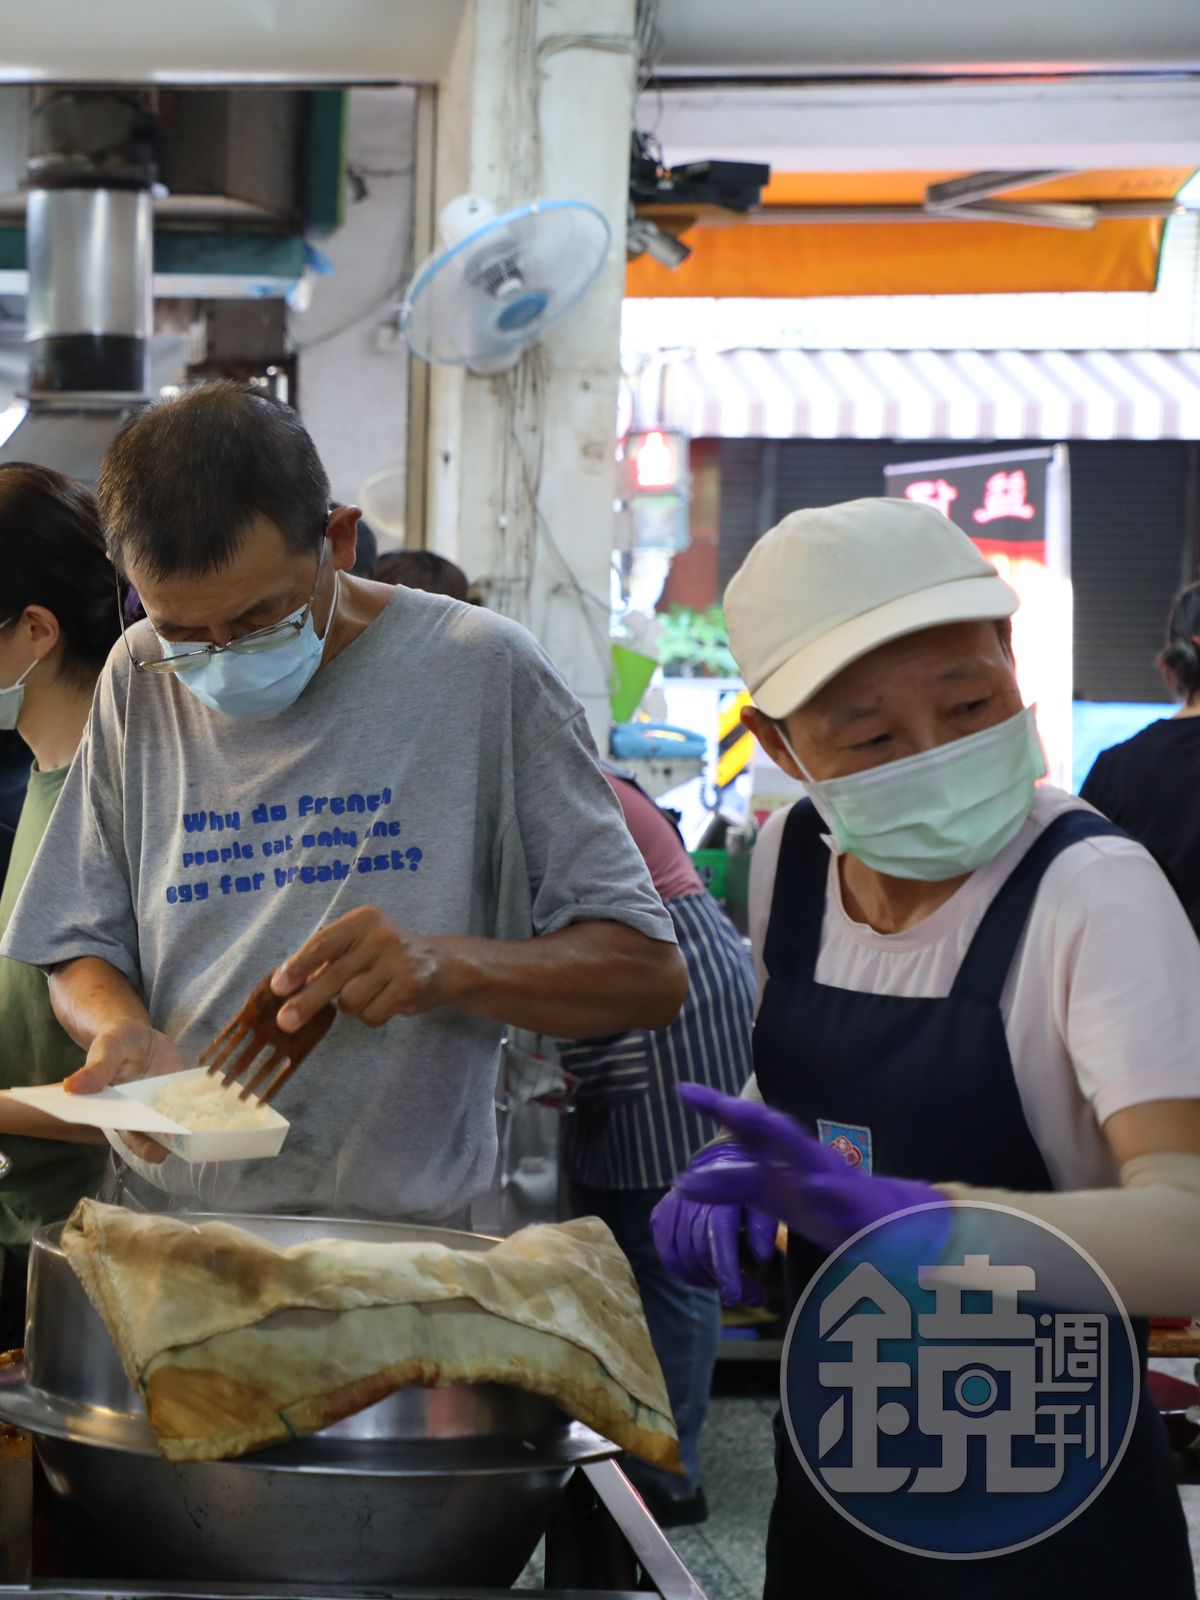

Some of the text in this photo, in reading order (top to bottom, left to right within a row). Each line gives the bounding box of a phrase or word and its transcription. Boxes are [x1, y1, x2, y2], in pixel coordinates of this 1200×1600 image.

[183, 811, 241, 833] Why
[251, 803, 287, 824] do
[182, 841, 254, 868] people
[262, 835, 293, 857] eat
[302, 827, 357, 848] only
[166, 846, 423, 904] egg for breakast?
